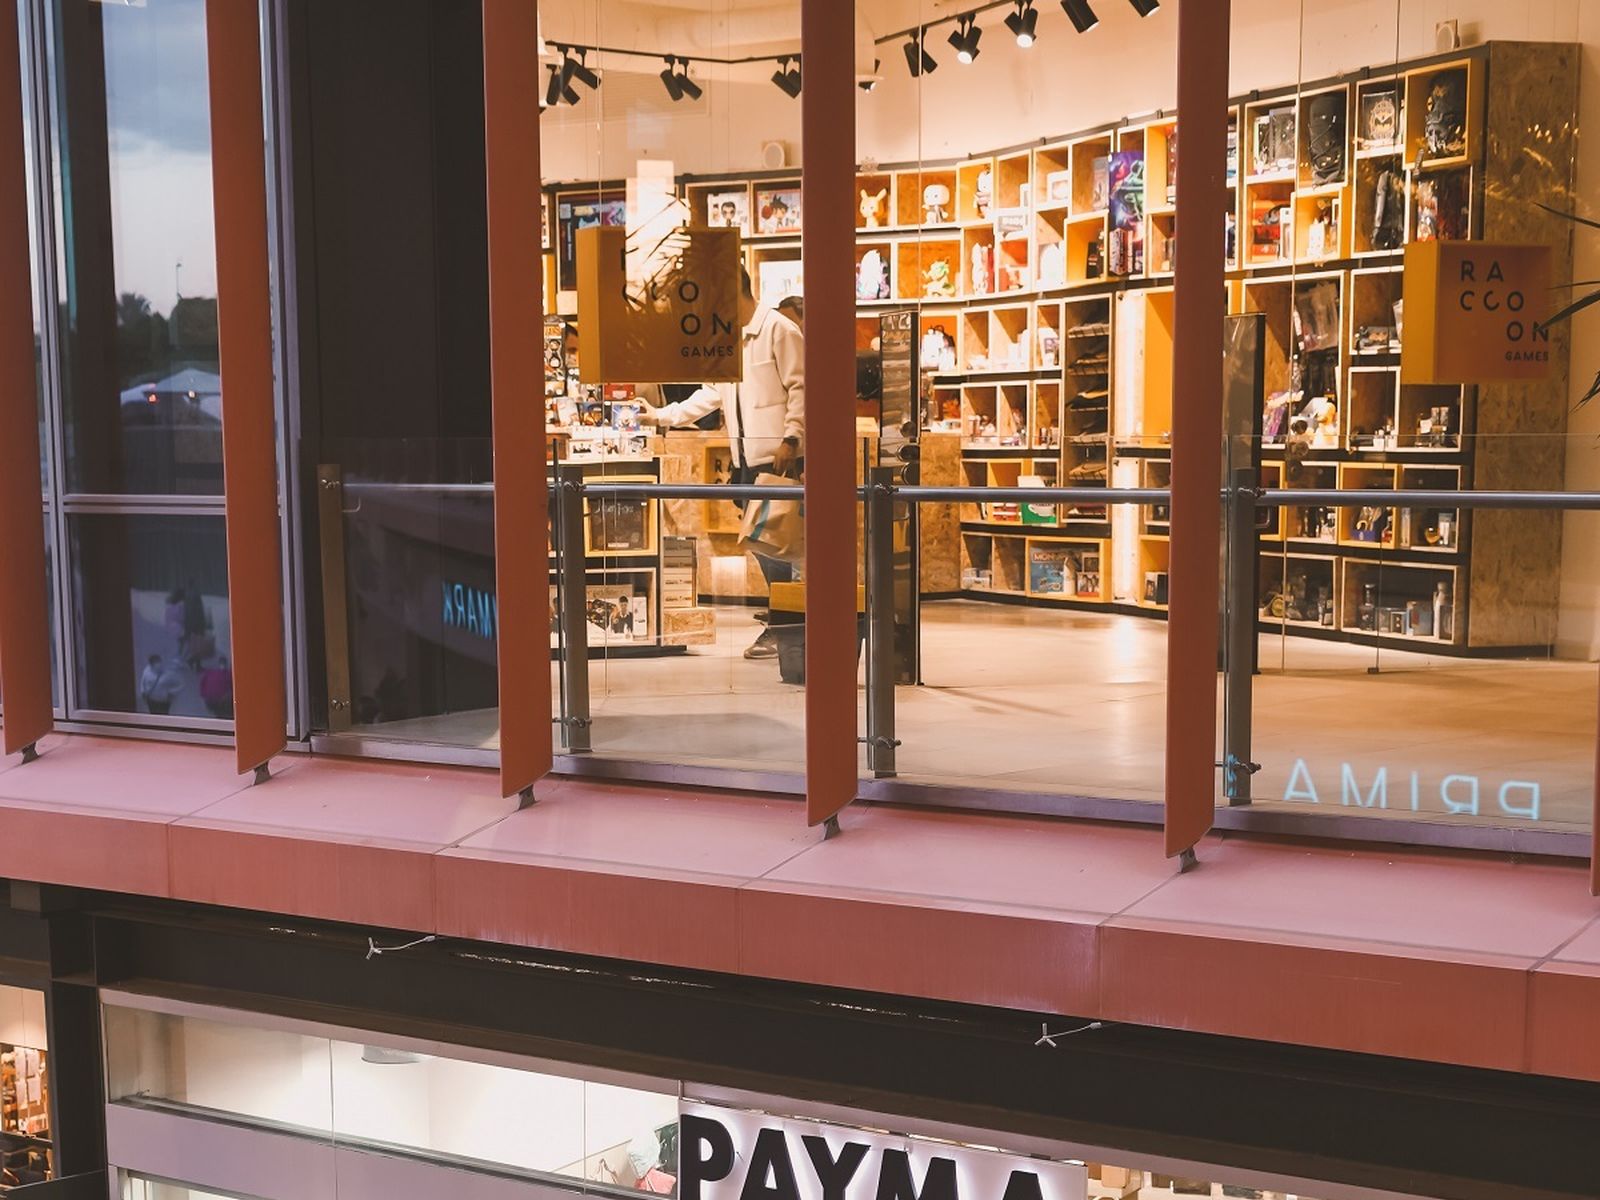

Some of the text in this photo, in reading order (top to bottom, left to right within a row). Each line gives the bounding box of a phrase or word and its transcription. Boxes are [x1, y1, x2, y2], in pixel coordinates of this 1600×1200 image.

[1461, 260, 1504, 281] RA
[1460, 290, 1524, 311] CCO
[680, 312, 732, 335] ON
[1506, 321, 1549, 341] ON
[680, 345, 734, 358] GAMES
[1505, 351, 1549, 362] GAMES
